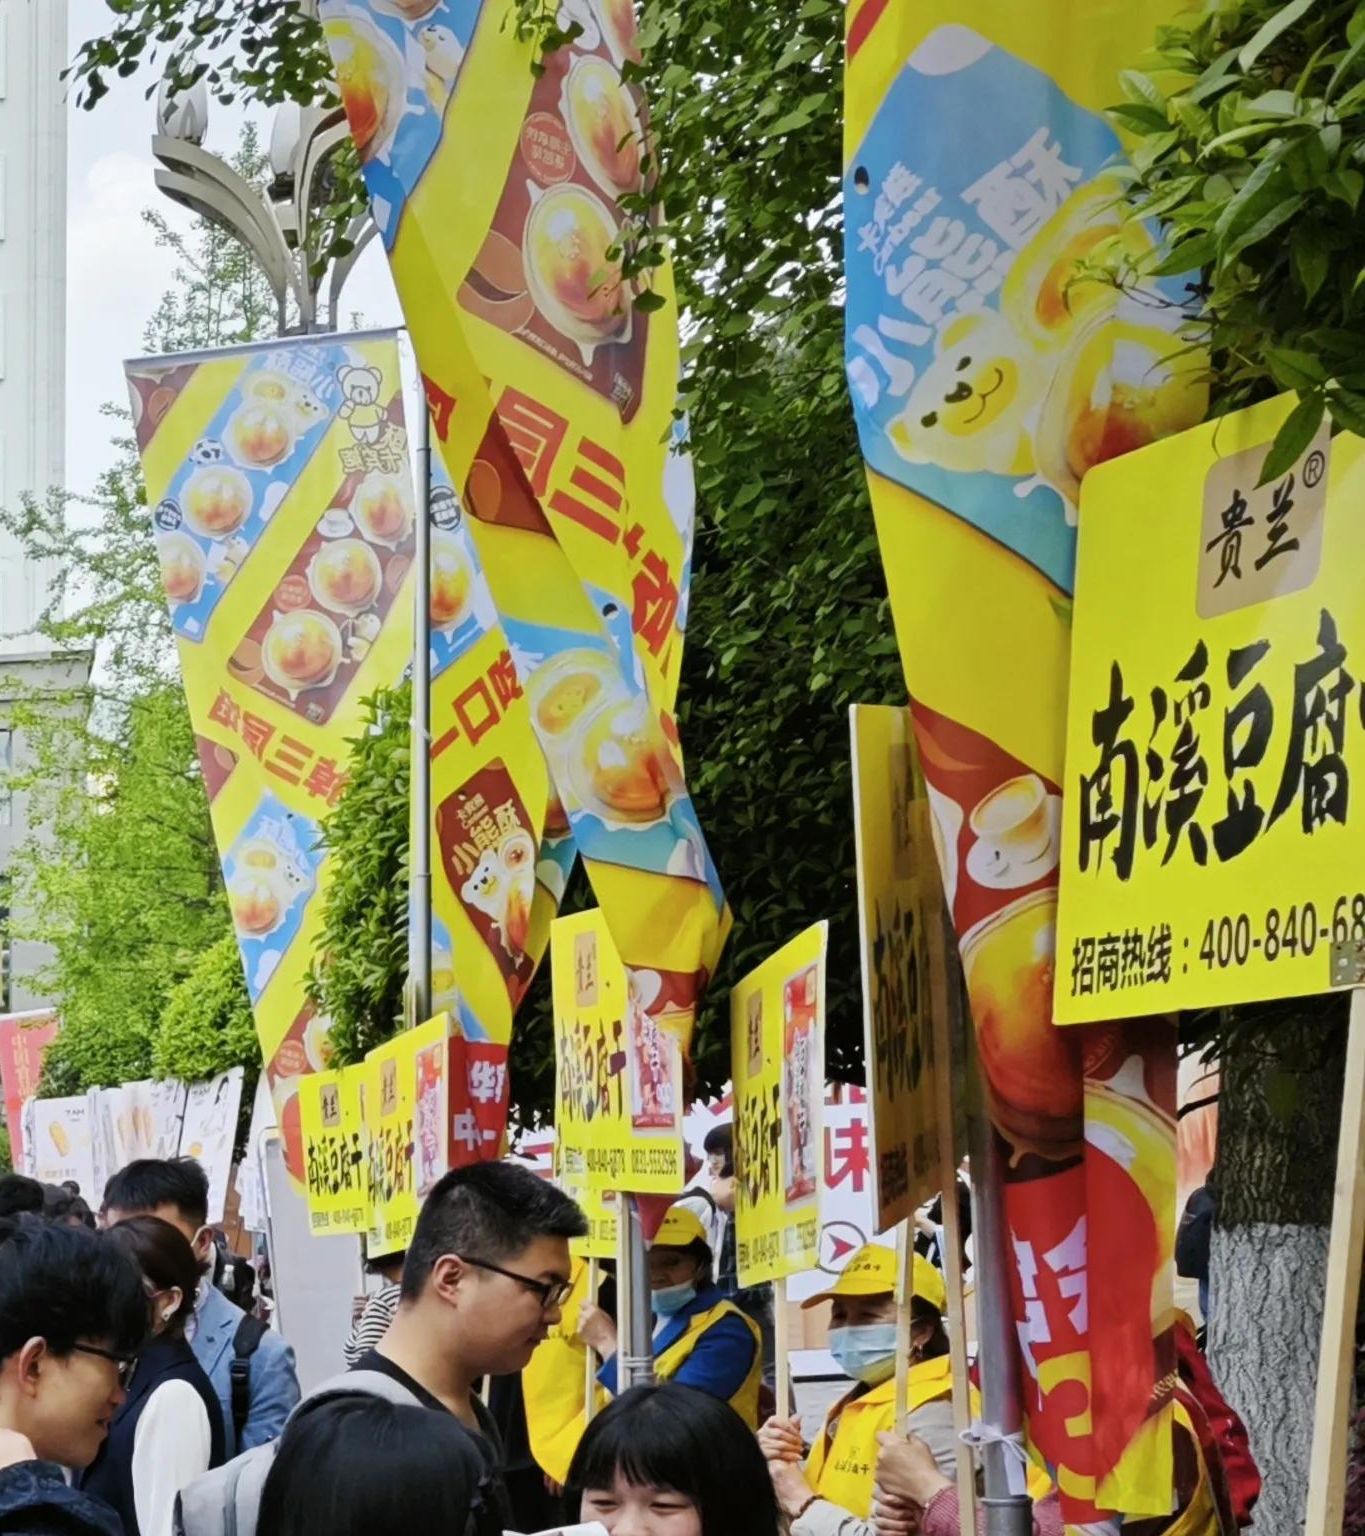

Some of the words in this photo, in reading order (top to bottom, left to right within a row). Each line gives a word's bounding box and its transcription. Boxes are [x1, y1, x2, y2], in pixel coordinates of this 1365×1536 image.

[1077, 606, 1365, 884] 南溪豆腐
[470, 1059, 508, 1105] 华
